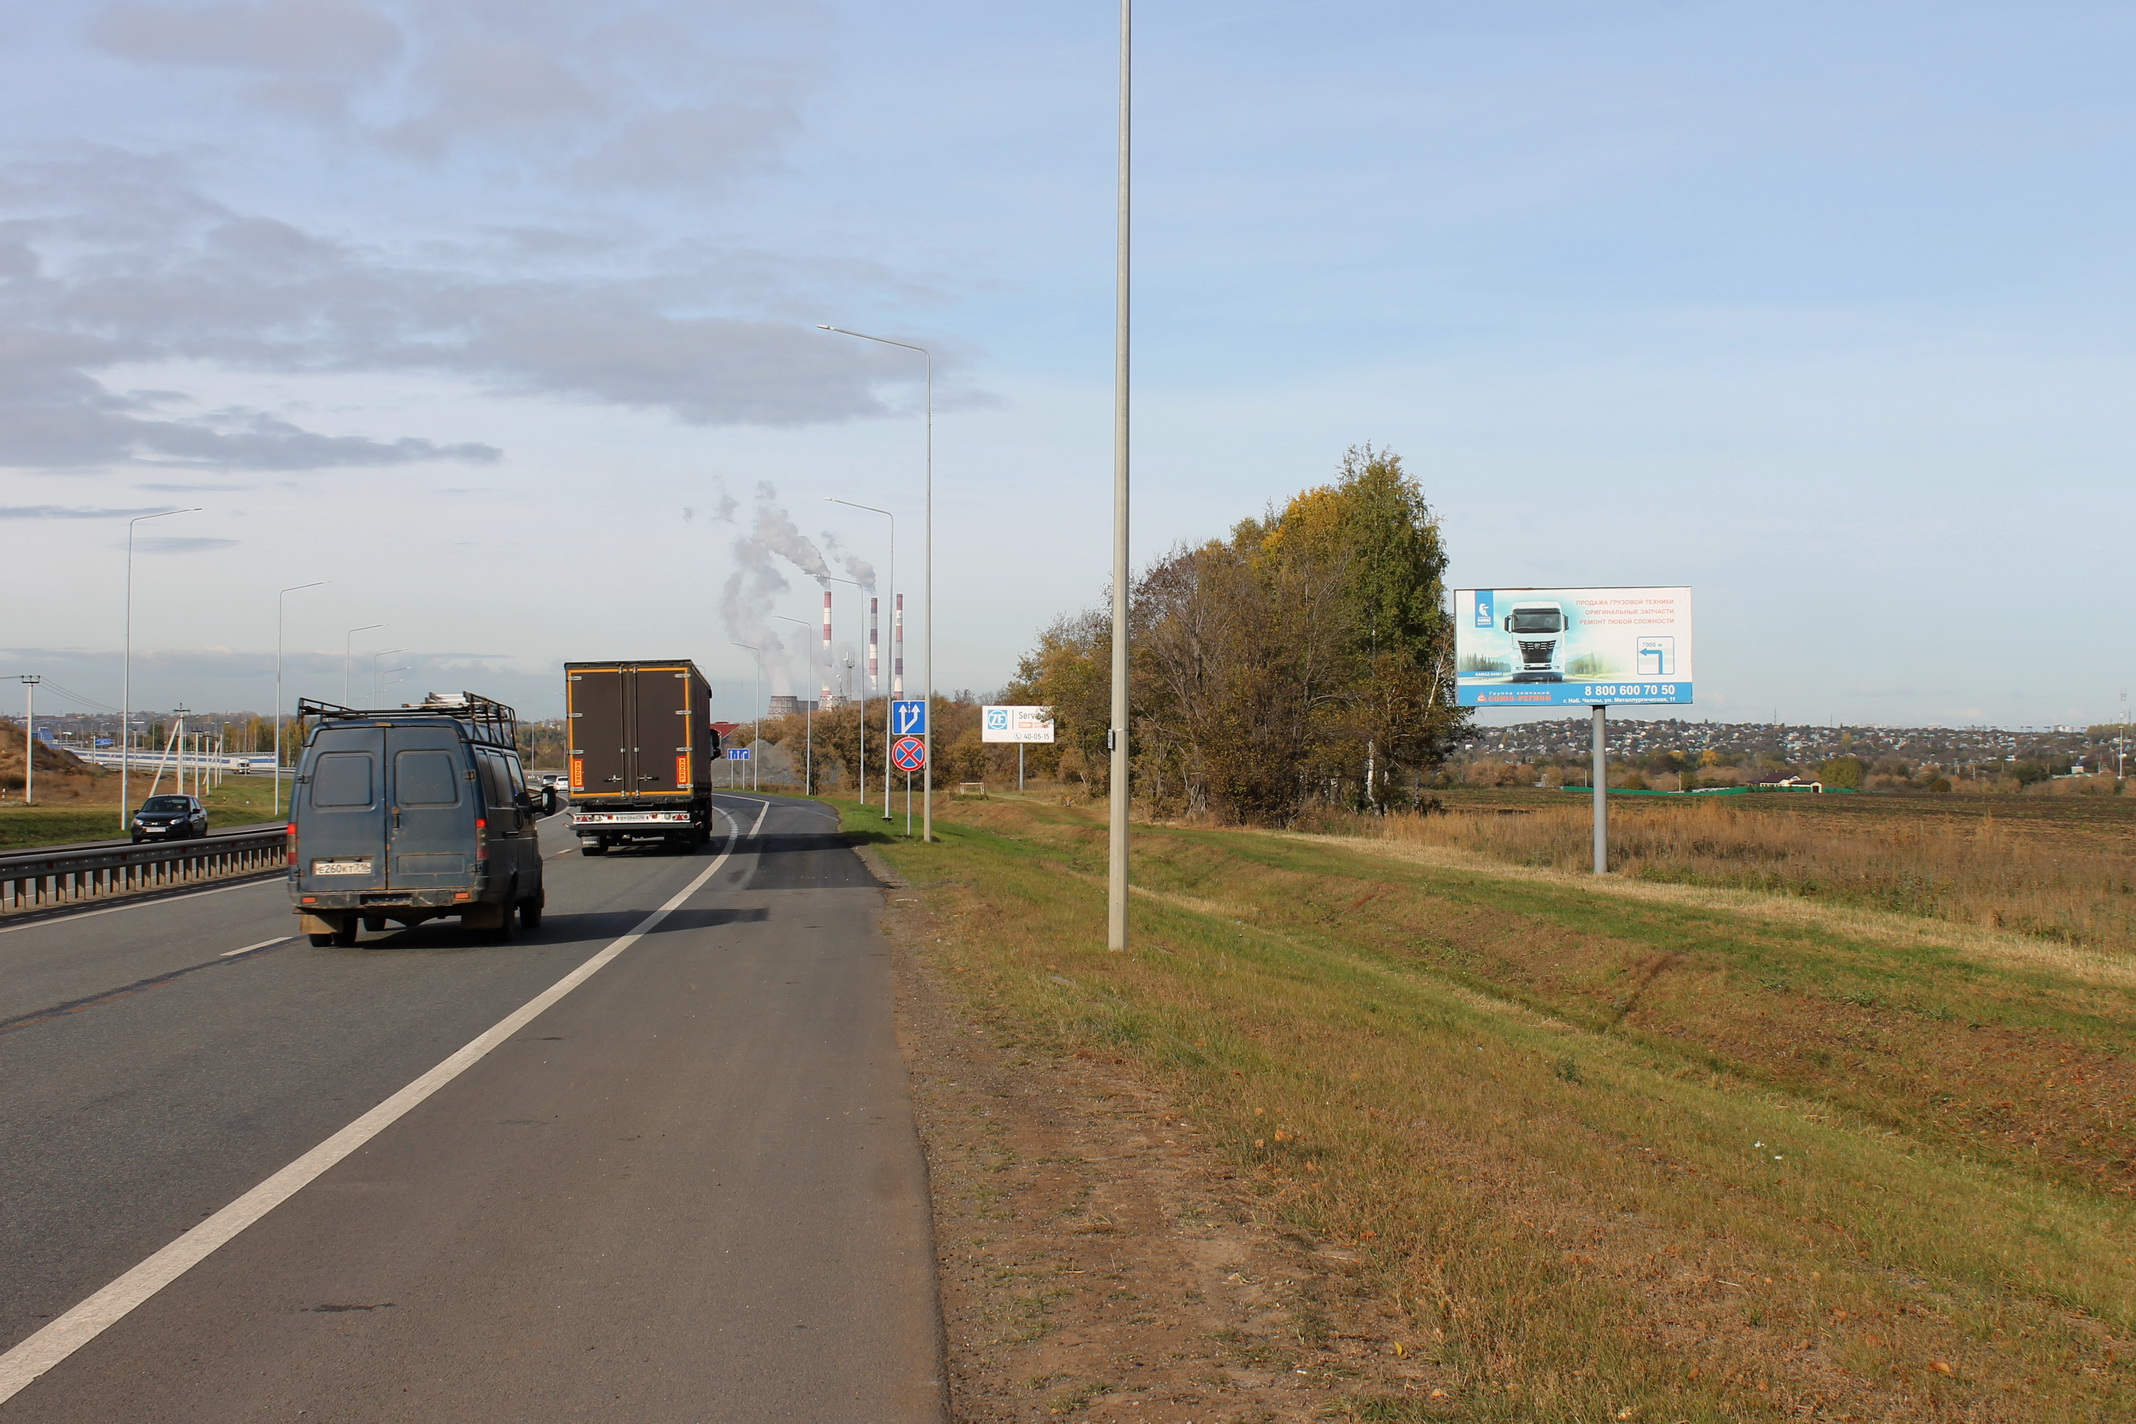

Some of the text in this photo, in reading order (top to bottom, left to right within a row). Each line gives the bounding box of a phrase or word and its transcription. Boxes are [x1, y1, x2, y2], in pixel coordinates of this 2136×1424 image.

[1584, 684, 1675, 696] 8 800 600 70 50
[990, 714, 1004, 725] ZF
